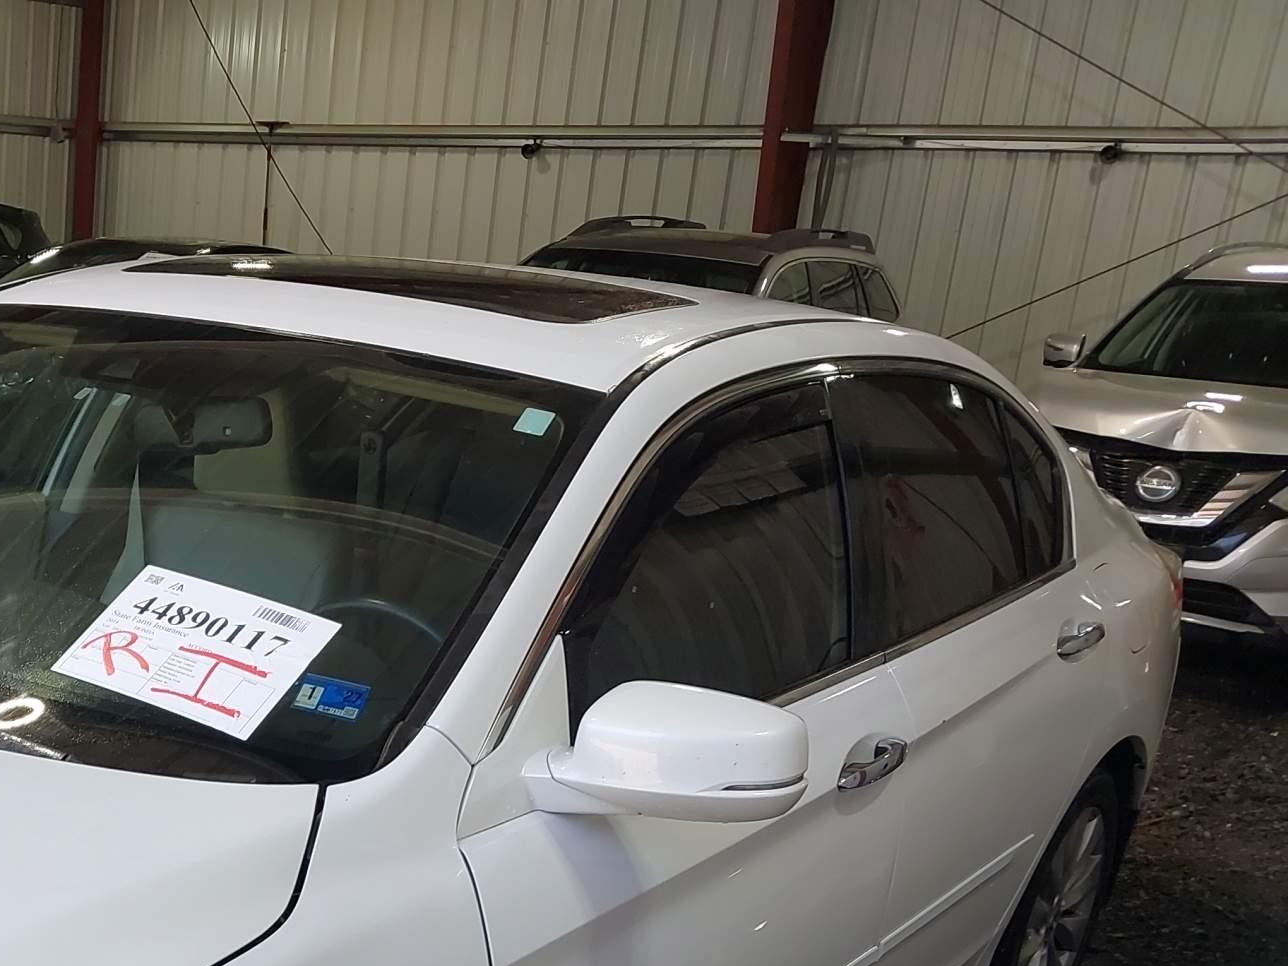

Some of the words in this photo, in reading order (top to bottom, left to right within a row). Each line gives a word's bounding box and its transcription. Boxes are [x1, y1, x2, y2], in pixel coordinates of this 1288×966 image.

[111, 609, 133, 620] State
[131, 615, 153, 627] Farm
[152, 621, 189, 639] Insurance
[132, 596, 292, 658] 44890117
[81, 631, 150, 676] R
[307, 685, 317, 701] 1
